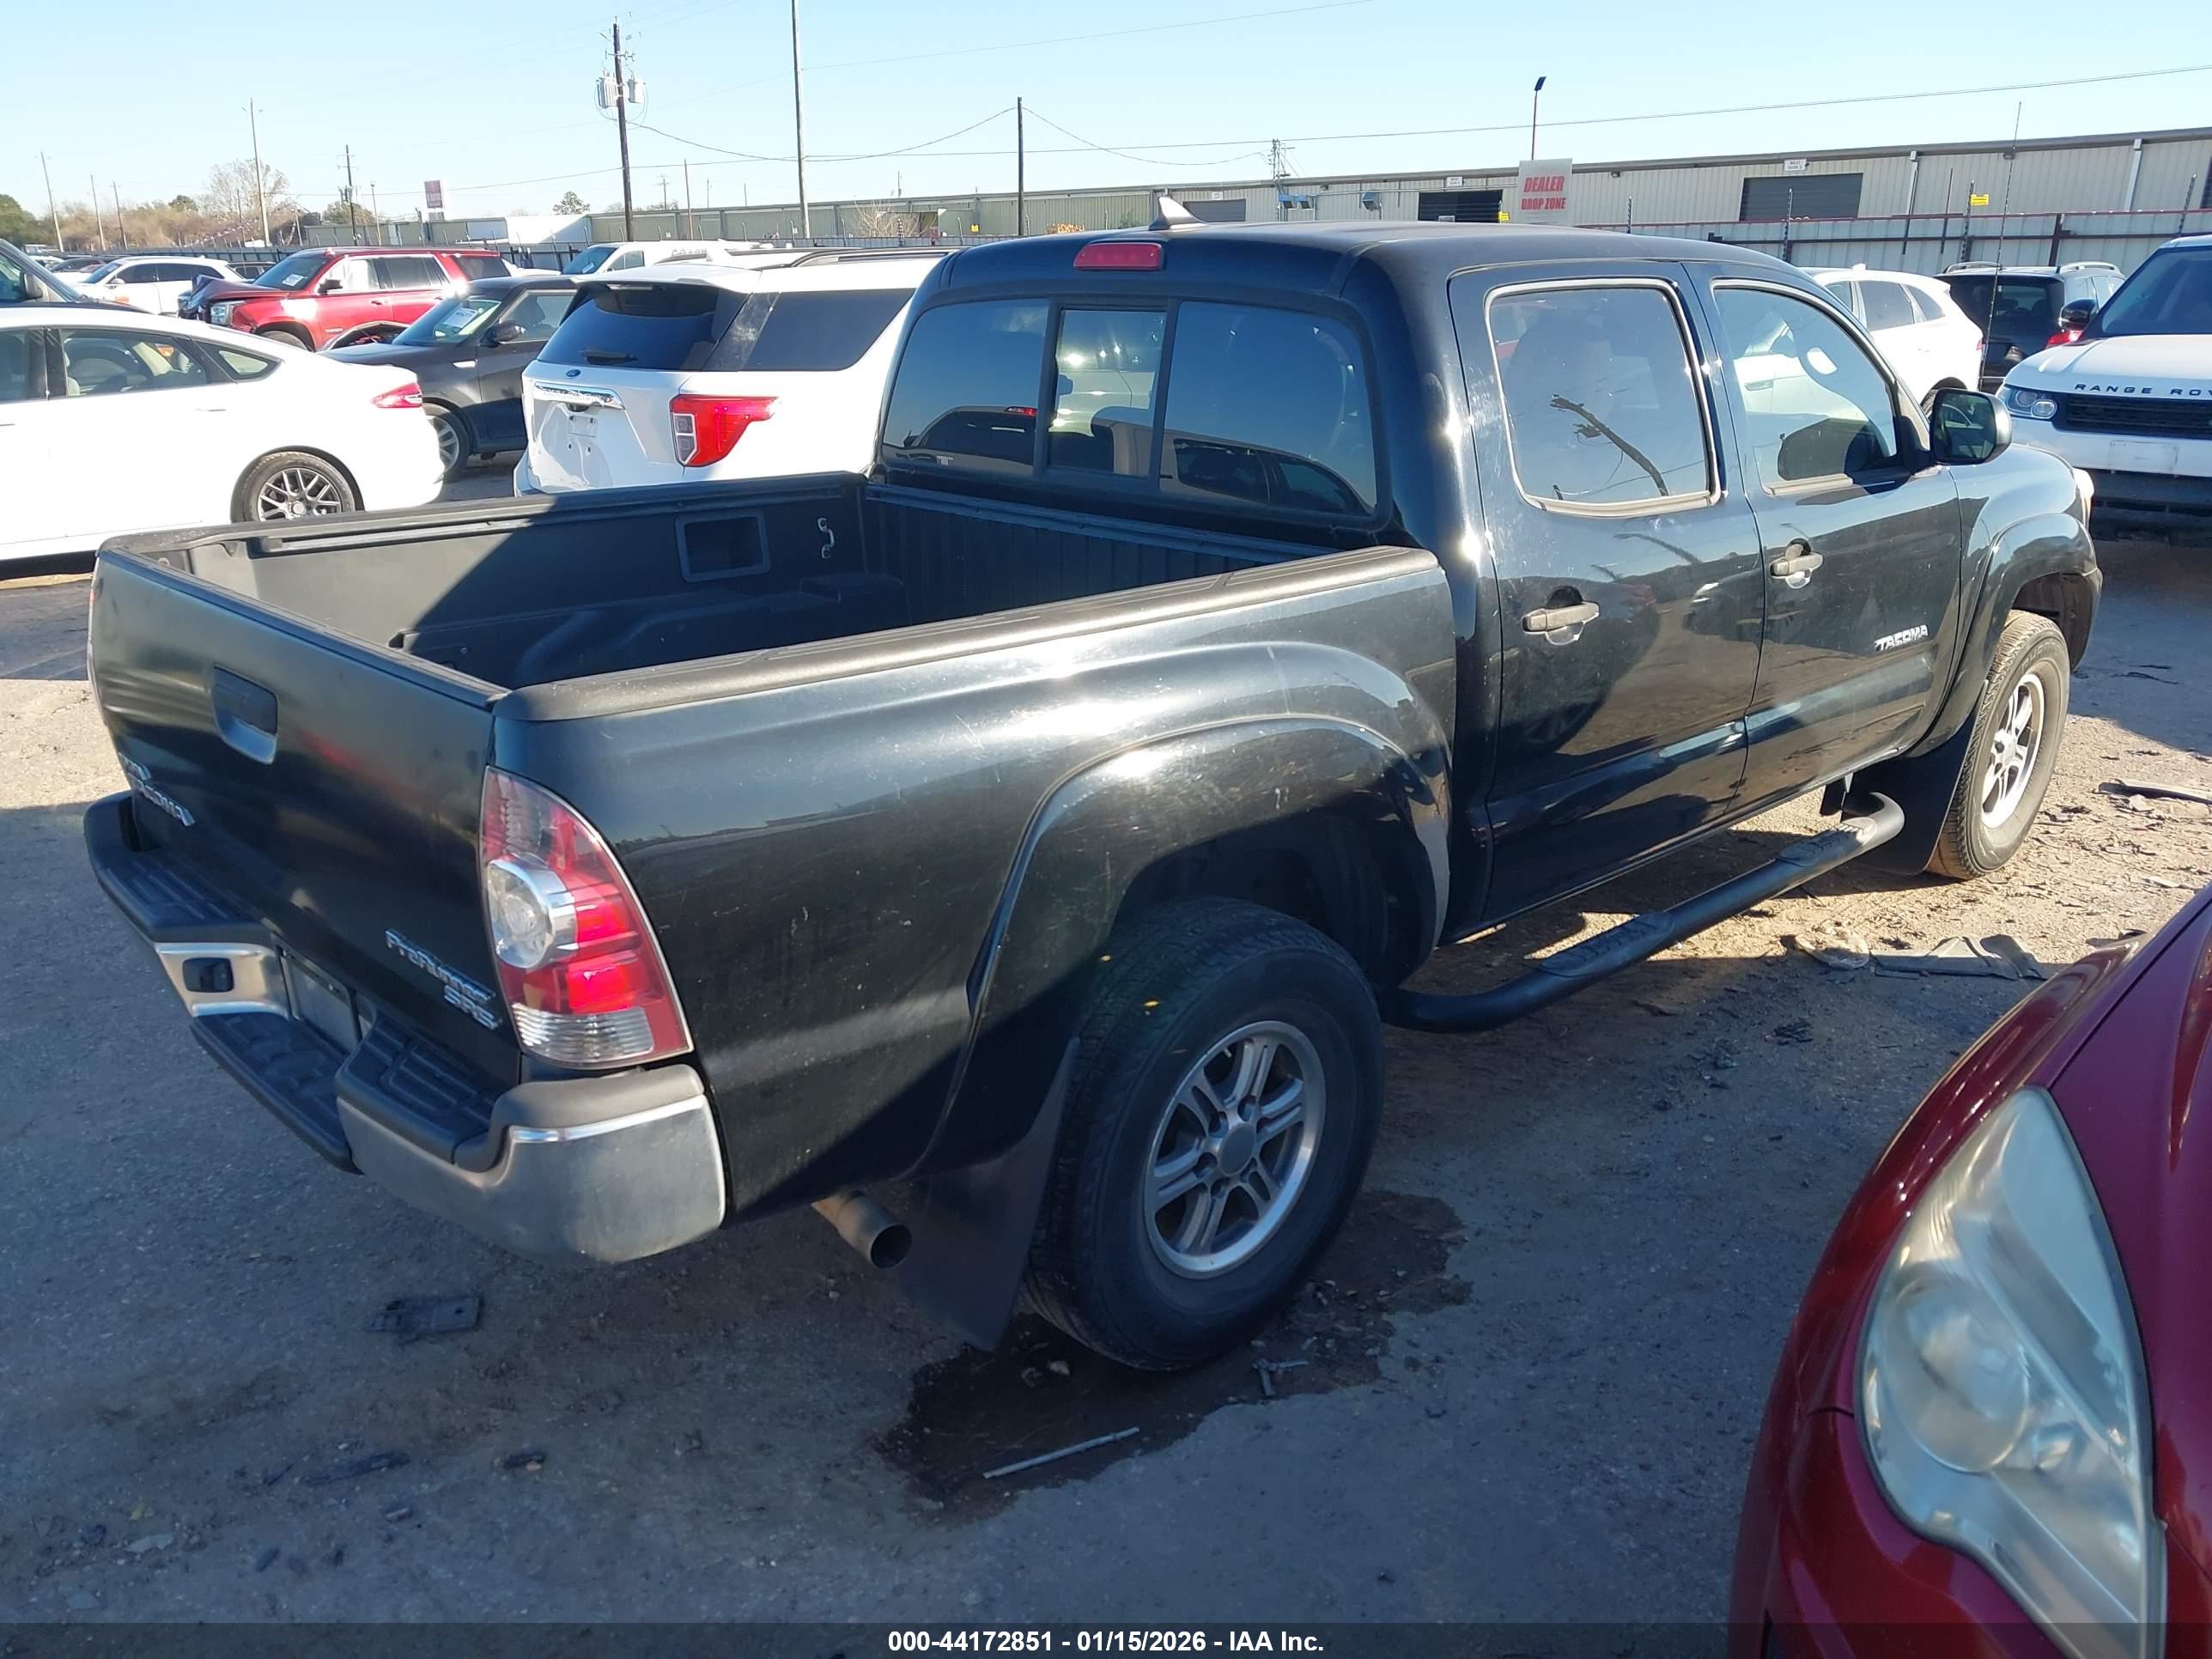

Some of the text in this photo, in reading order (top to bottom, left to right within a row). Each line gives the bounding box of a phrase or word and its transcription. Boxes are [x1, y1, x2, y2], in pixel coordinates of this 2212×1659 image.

[1523, 176, 1565, 192] DEALER
[1521, 197, 1567, 210] DROP ZONE
[2074, 383, 2154, 395] RANGE
[1874, 624, 1929, 652] TACOMA
